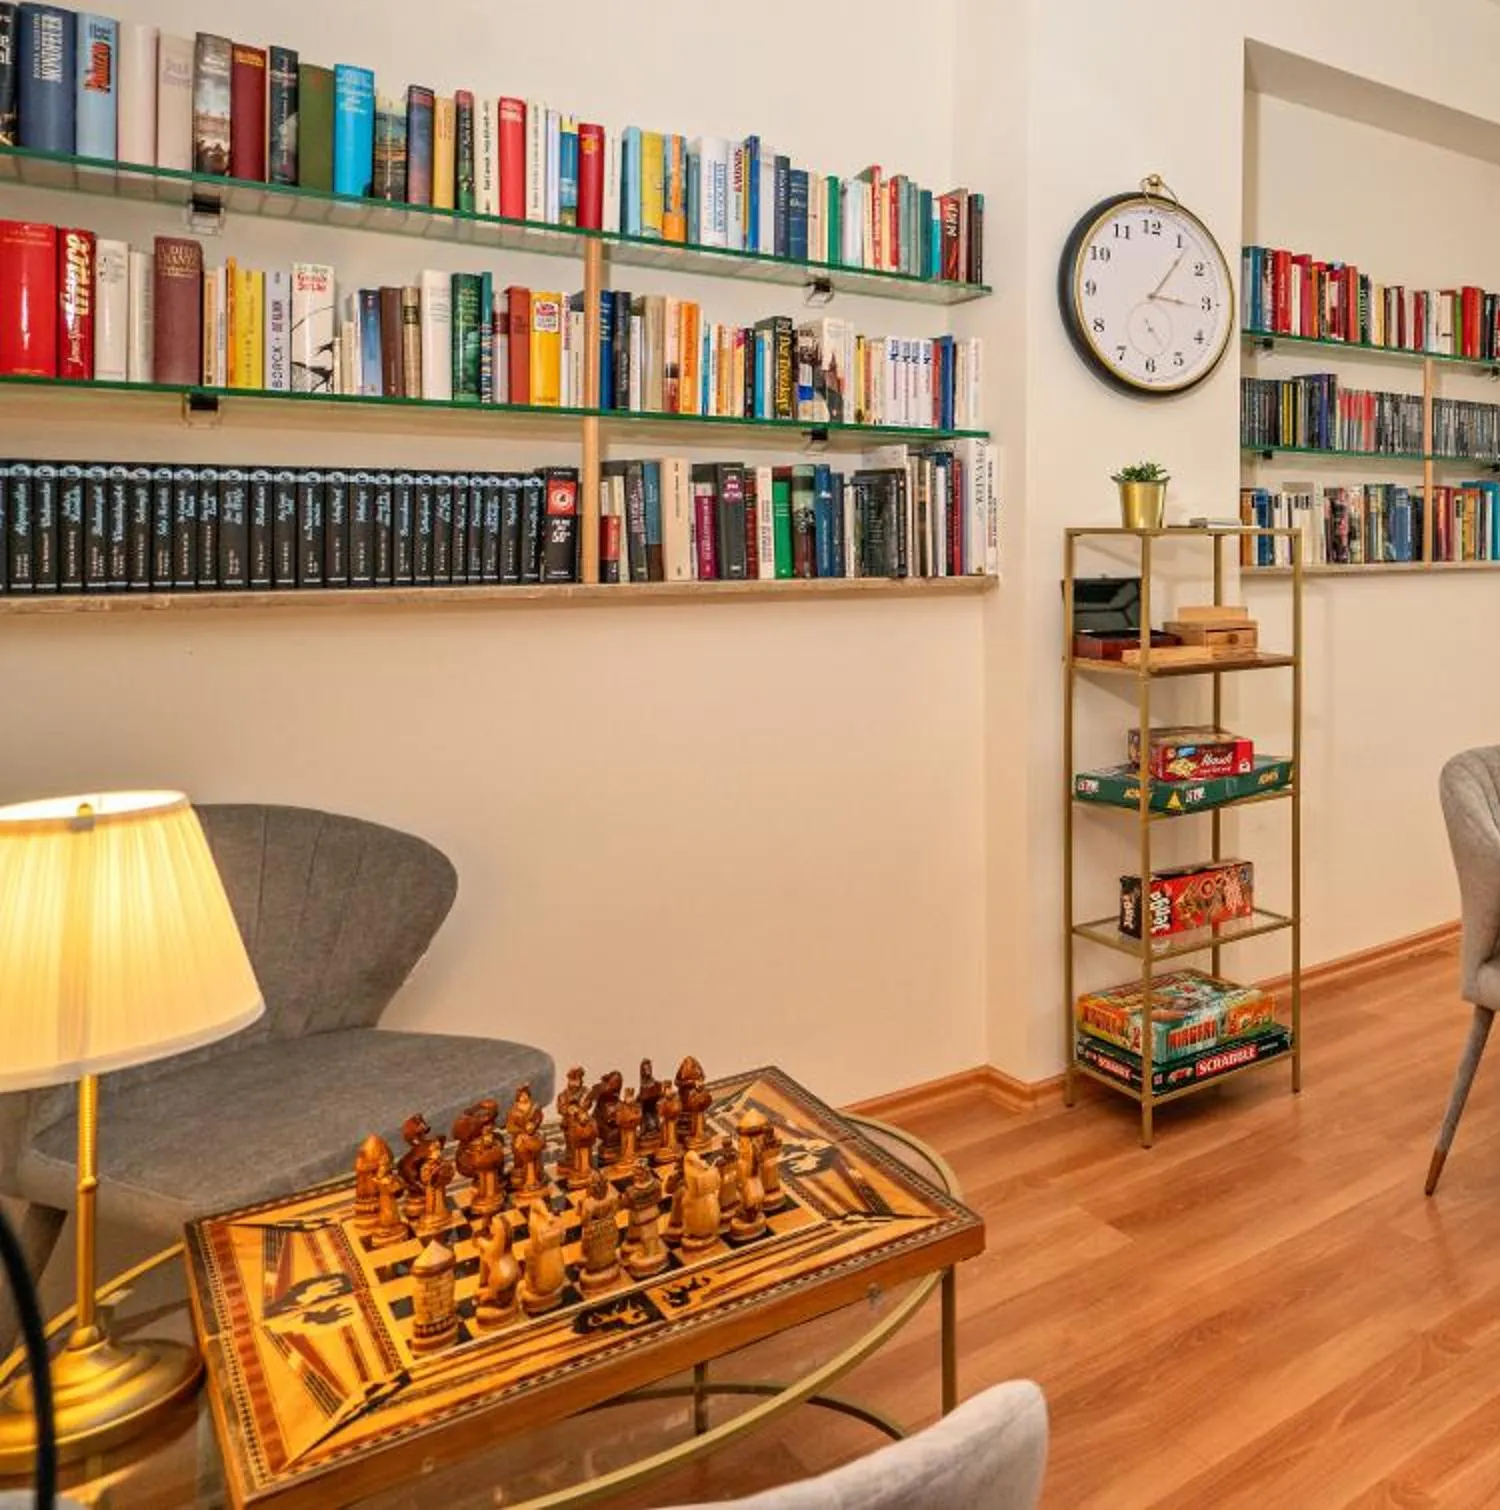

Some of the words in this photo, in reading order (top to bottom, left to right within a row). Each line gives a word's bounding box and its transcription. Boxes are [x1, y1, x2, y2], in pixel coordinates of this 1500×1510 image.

[1113, 223, 1131, 241] 11
[1142, 219, 1162, 236] 12
[1175, 234, 1183, 249] 1
[1090, 245, 1111, 261] 10
[1194, 262, 1205, 277] 2
[1085, 279, 1097, 297] 9
[1202, 296, 1212, 312] 3
[1093, 318, 1105, 333] 8
[1194, 330, 1205, 345] 4
[1116, 345, 1127, 361] 7
[1173, 352, 1184, 367] 5
[1145, 359, 1156, 373] 6
[1198, 1046, 1257, 1077] SCRABBLE
